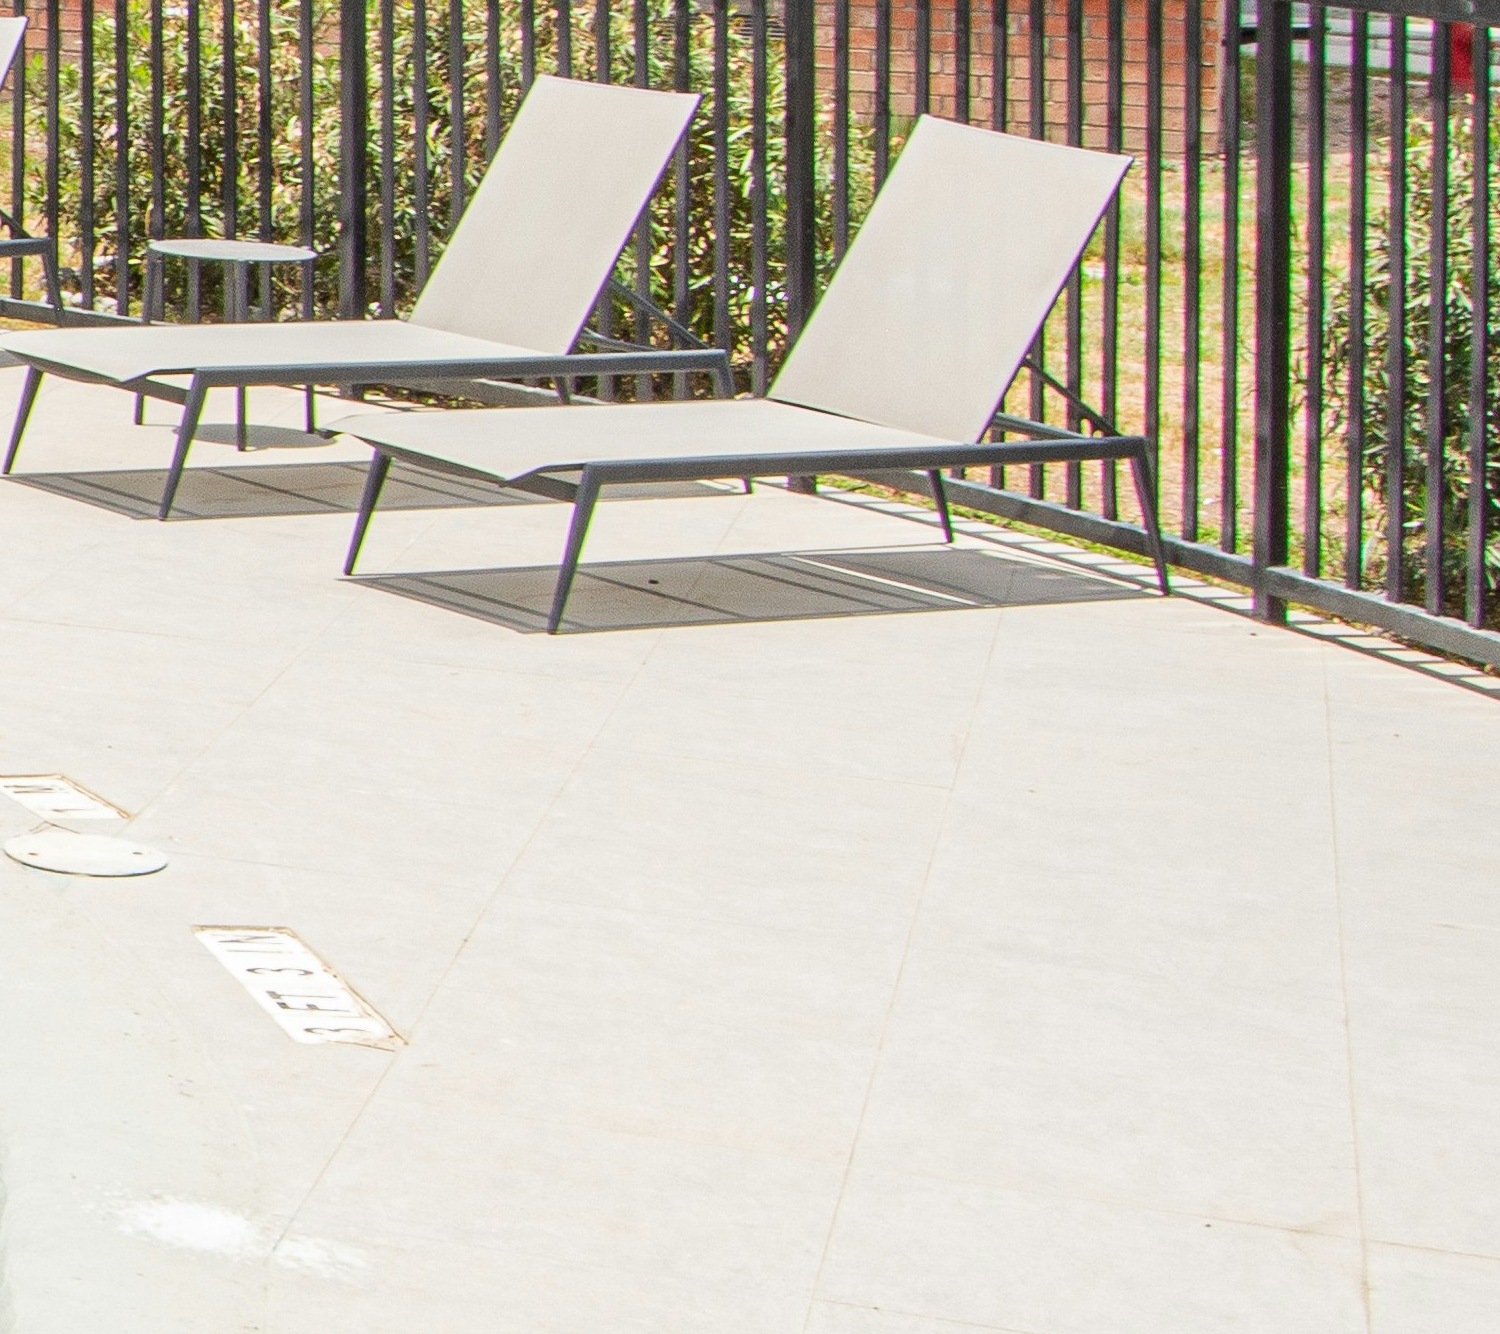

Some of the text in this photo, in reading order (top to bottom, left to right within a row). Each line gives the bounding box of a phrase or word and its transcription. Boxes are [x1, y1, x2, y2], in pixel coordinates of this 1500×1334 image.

[211, 933, 294, 955] IN
[245, 967, 315, 976] 3
[265, 990, 352, 1013] FT
